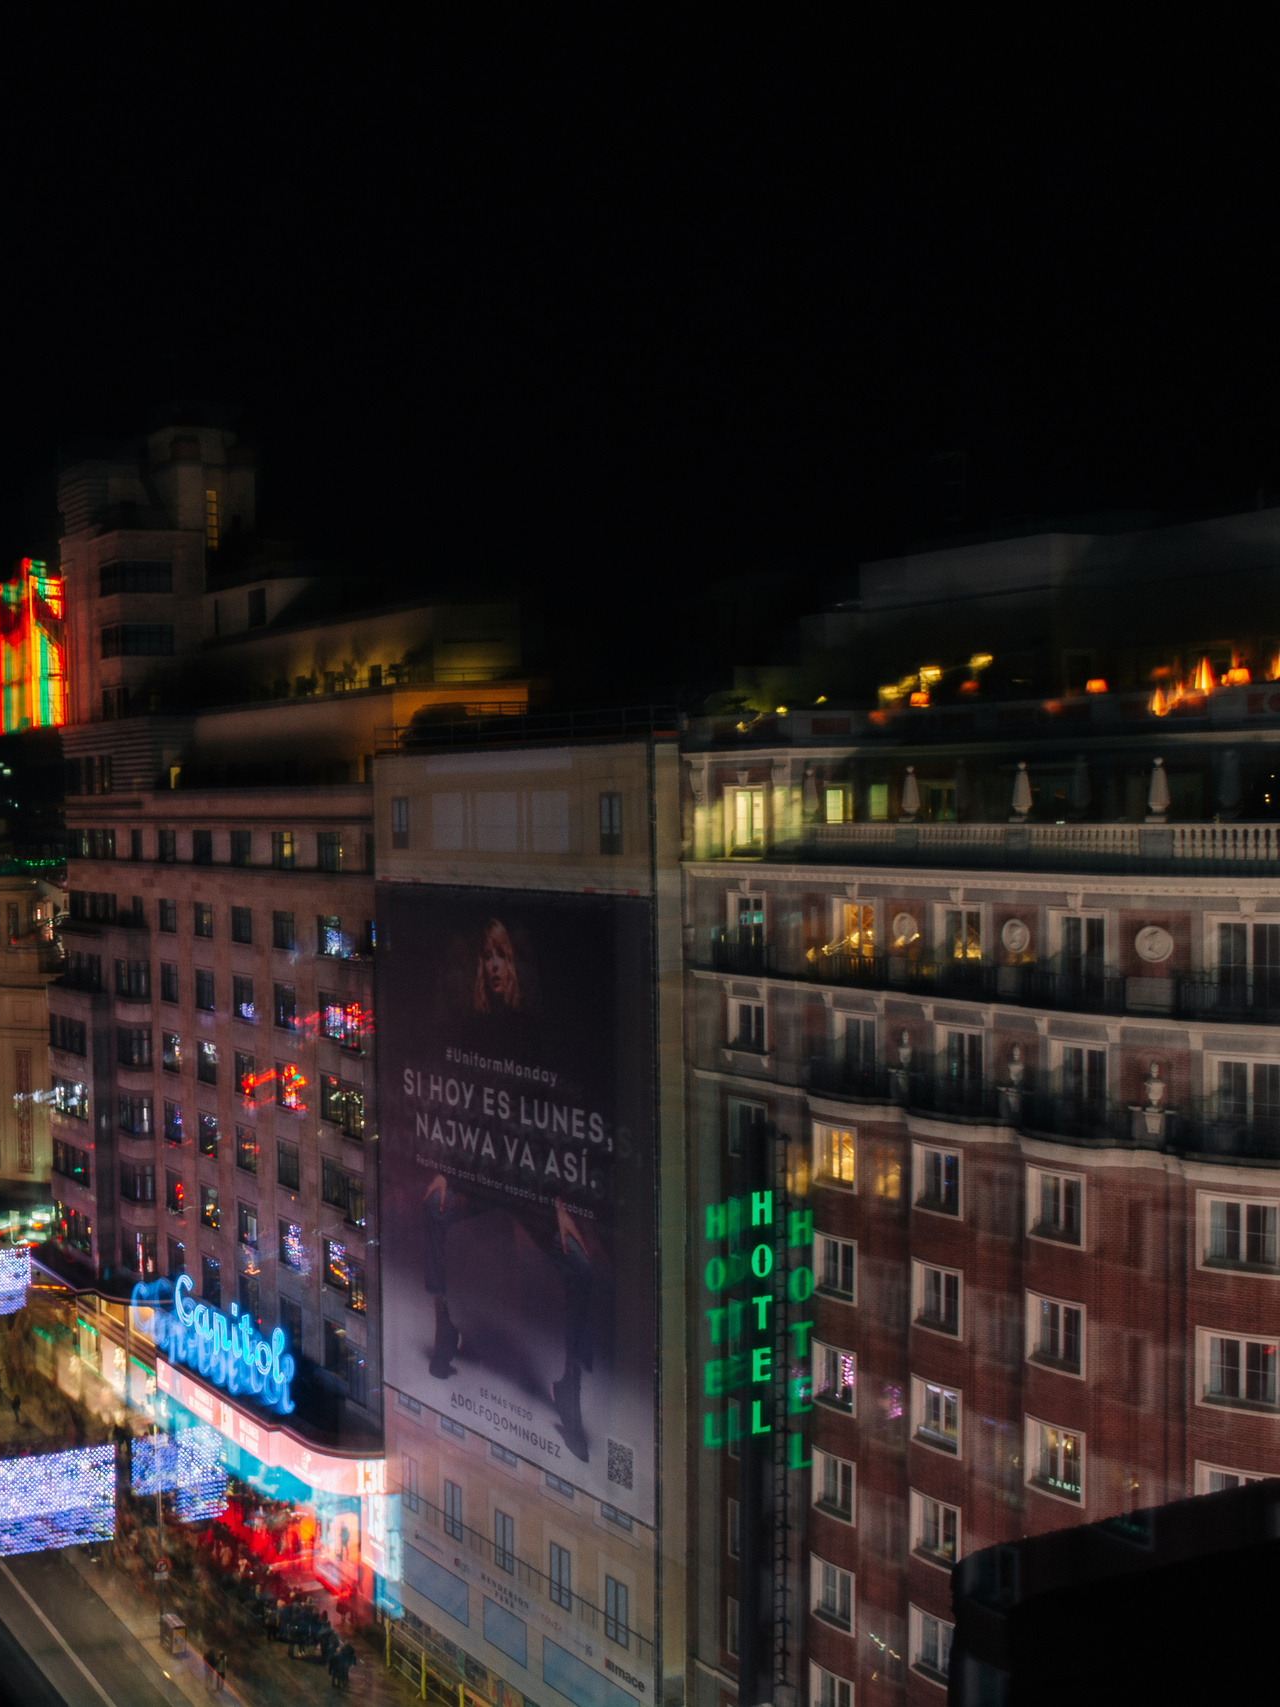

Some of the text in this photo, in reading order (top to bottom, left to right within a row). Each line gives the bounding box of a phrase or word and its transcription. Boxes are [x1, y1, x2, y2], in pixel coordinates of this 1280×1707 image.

[446, 1047, 558, 1088] #UniformMonday
[403, 1068, 613, 1152] SI HOY ES LUNES,
[416, 1112, 596, 1188] NAJWA VA ASÍ.
[439, 1162, 456, 1176] ropa
[458, 1170, 476, 1182] para
[476, 1173, 503, 1190] liberar
[504, 1182, 537, 1201] espacio
[538, 1194, 548, 1205] en
[751, 1190, 773, 1435] HOTEL
[450, 1392, 561, 1458] ADOLFODOMINGUEZ
[480, 1573, 530, 1610] HENDERSON
[614, 1666, 646, 1692] mace
